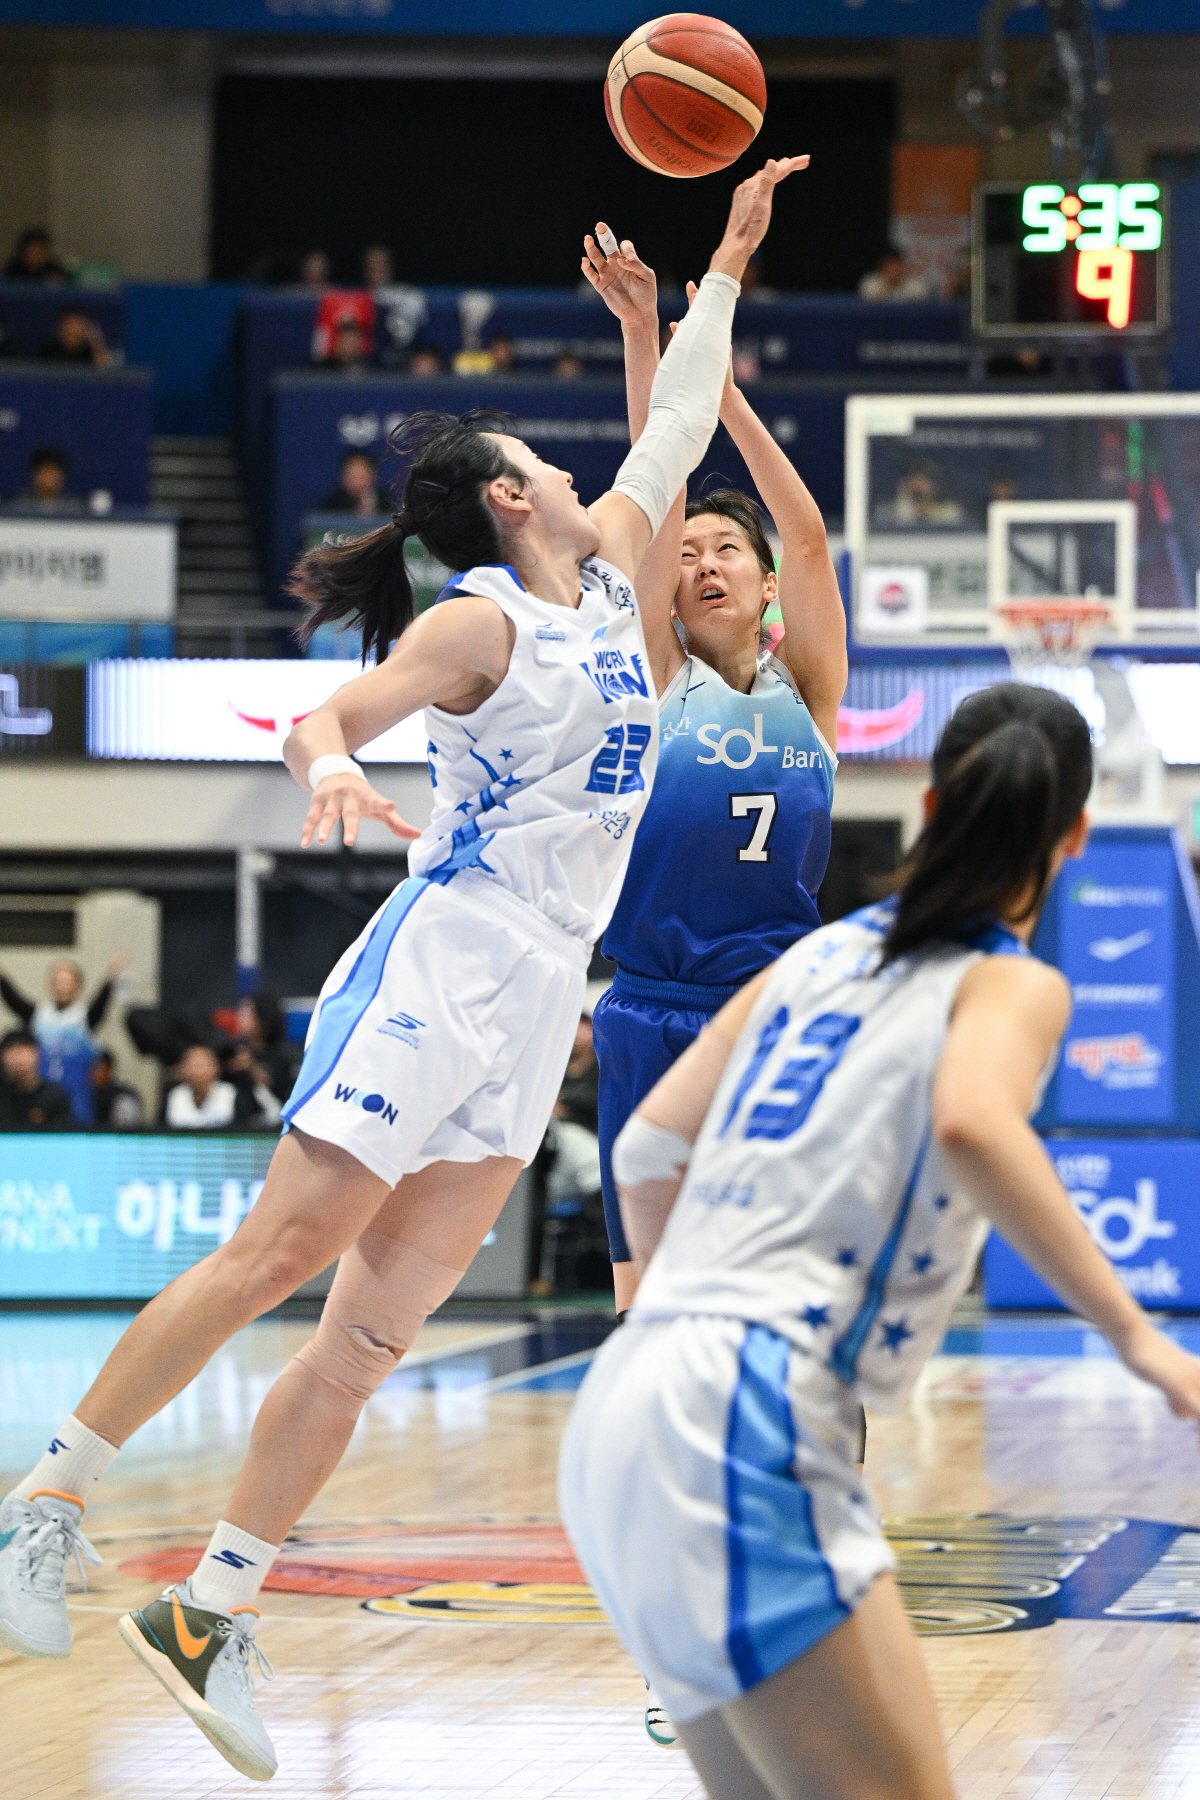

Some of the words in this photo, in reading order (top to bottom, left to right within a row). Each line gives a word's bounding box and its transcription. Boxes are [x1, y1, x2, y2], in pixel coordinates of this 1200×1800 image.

[647, 134, 708, 173] molten
[1022, 183, 1163, 252] 5:35
[1076, 246, 1133, 329] 9
[584, 724, 651, 795] 23
[781, 745, 823, 769] Ban
[728, 792, 779, 863] 7
[716, 1005, 862, 1142] 13
